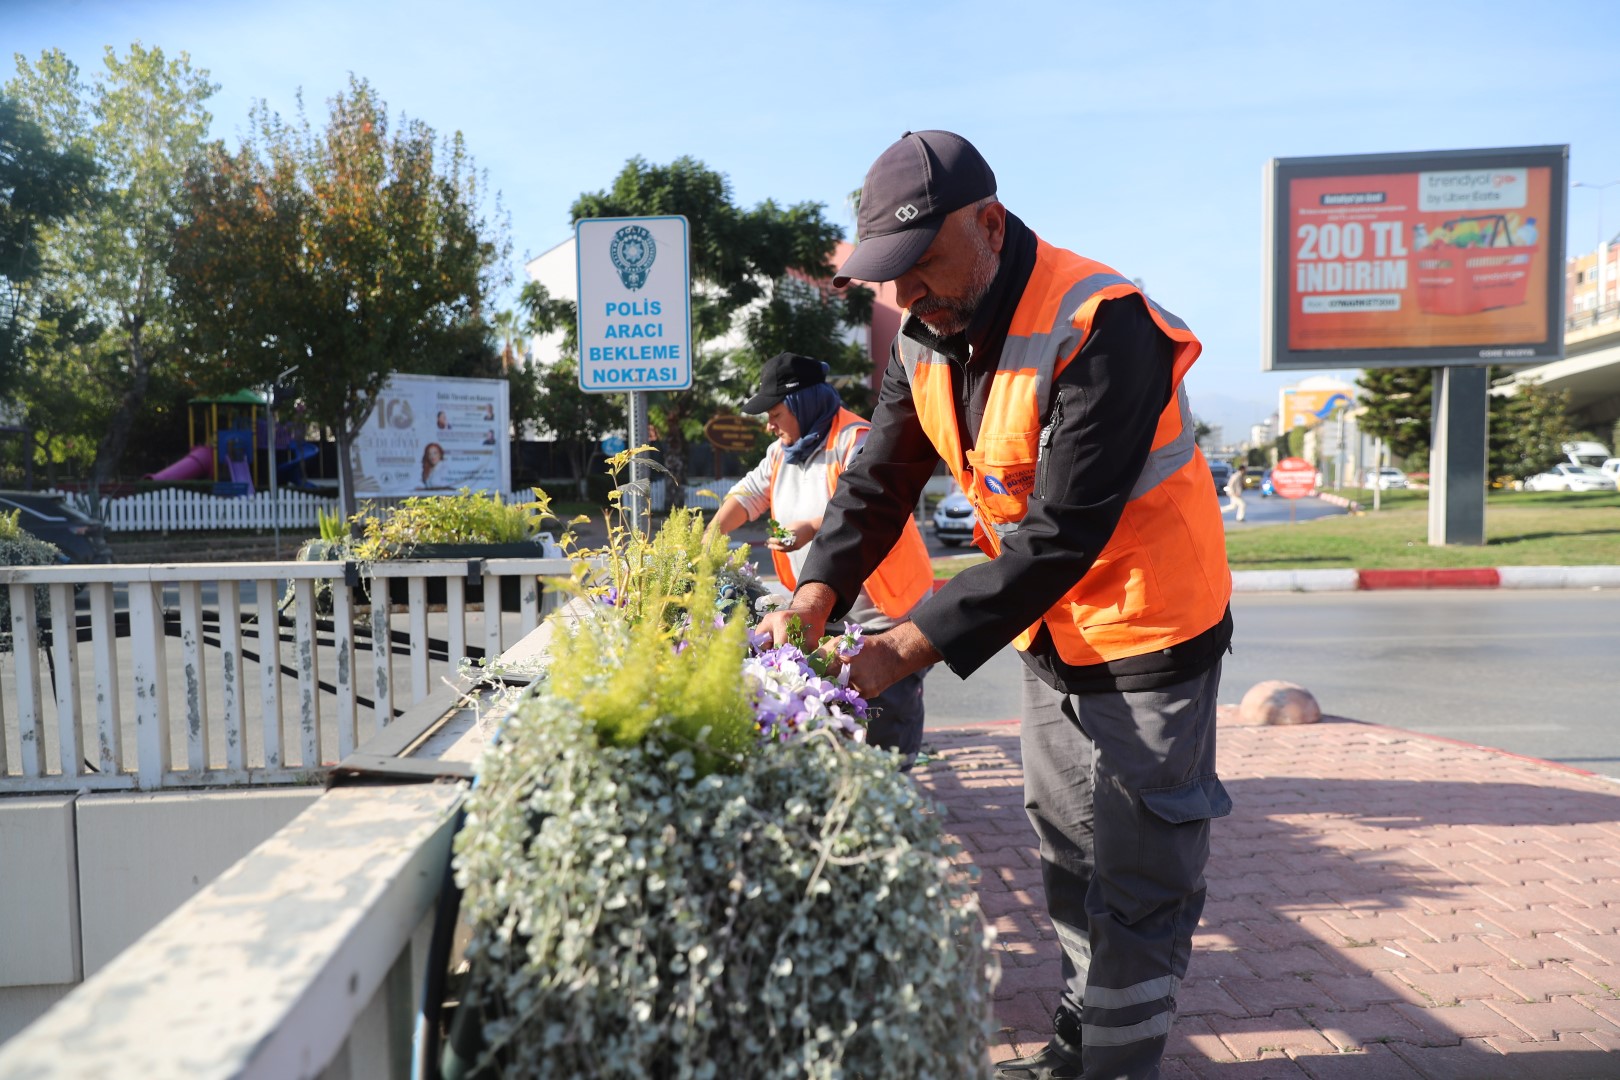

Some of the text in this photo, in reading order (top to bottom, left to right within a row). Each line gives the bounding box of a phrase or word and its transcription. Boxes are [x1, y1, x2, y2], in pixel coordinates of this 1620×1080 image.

[1296, 220, 1409, 260] 200 TL
[605, 298, 662, 317] POLİS
[604, 323, 663, 339] ARACI
[589, 345, 680, 361] BEKLEME
[593, 367, 677, 383] NOKTASI
